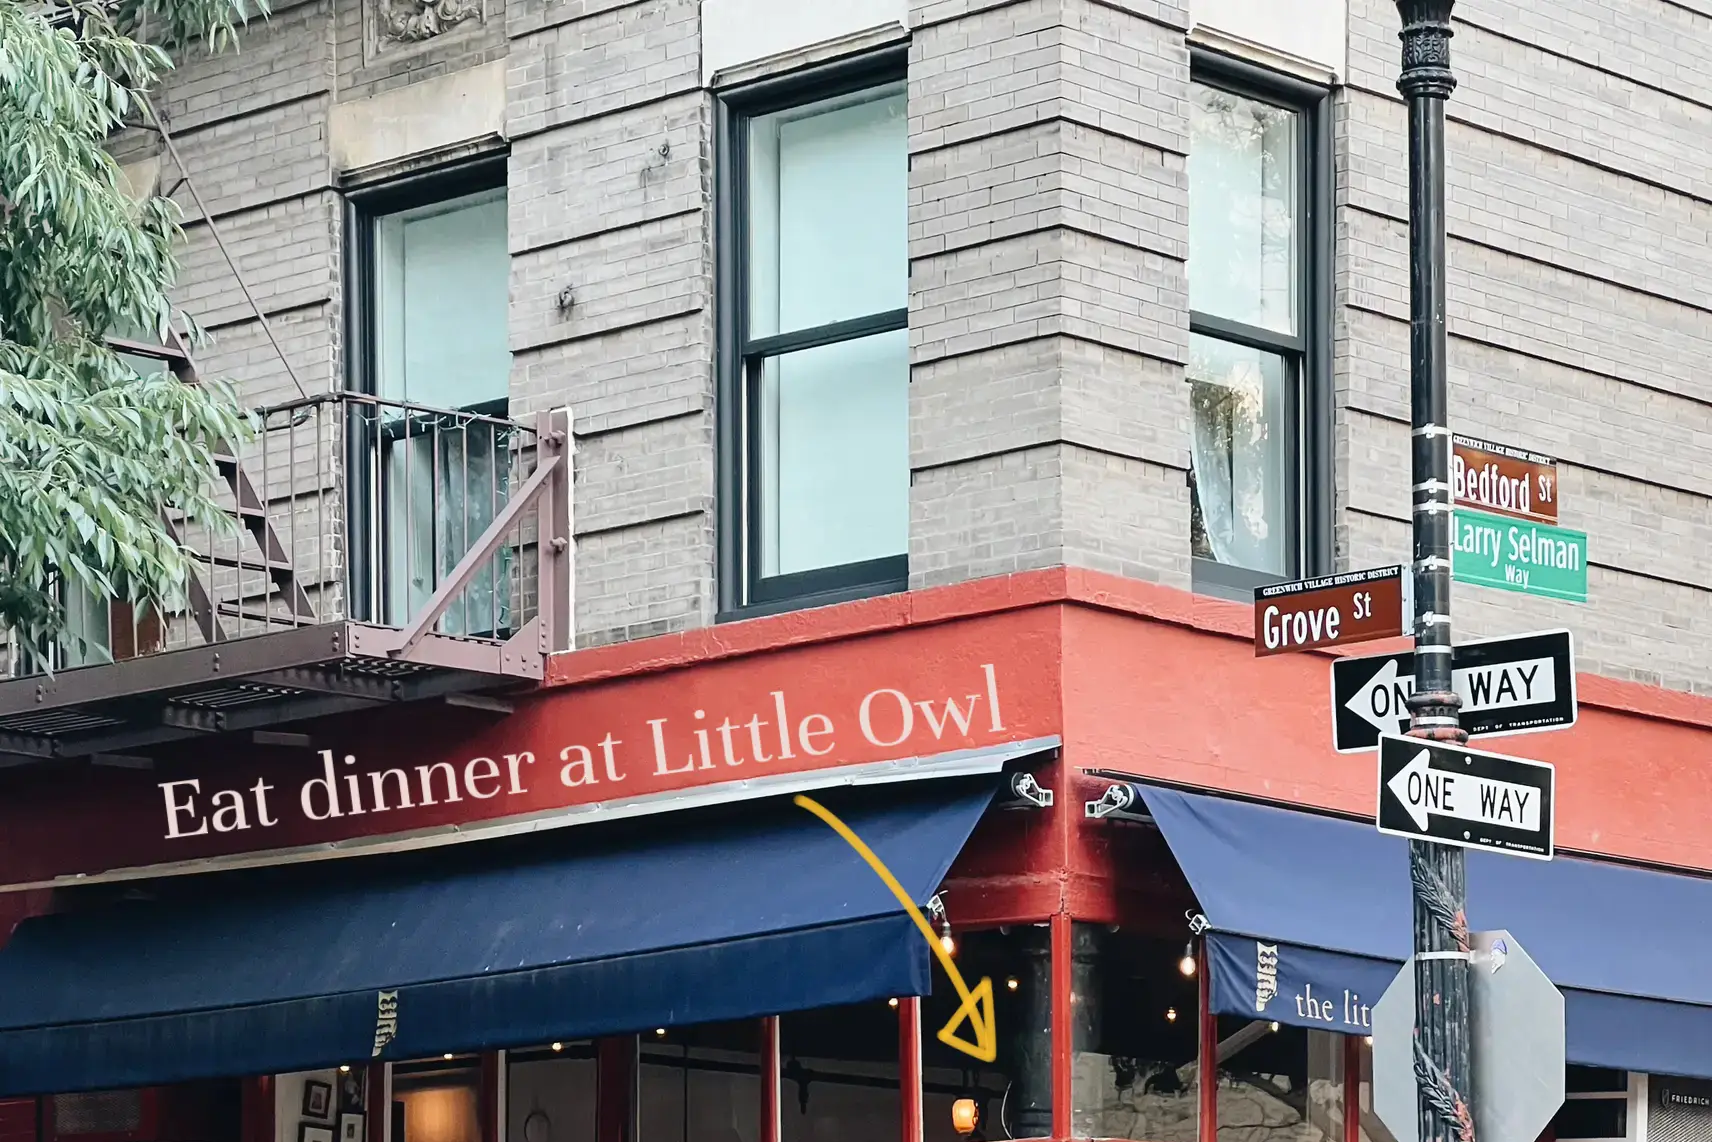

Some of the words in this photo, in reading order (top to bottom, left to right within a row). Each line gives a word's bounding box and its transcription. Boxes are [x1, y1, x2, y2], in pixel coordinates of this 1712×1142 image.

[1453, 435, 1483, 450] GREENWICH
[1484, 442, 1505, 455] VILLAGE
[1453, 455, 1530, 513] Bedford
[1538, 475, 1552, 503] St
[1454, 516, 1502, 567] Larry
[1508, 526, 1579, 571] Selman
[1263, 582, 1303, 596] GREENWICH
[1304, 577, 1333, 590] VILLAGE
[1335, 572, 1366, 585] HISTORIC
[1367, 566, 1399, 580] DISTRICT
[1505, 564, 1529, 589] Way
[1263, 605, 1340, 649] Grove
[1353, 592, 1371, 620] St
[1371, 681, 1412, 718] ON
[1468, 665, 1539, 706] WAY
[1509, 717, 1564, 727] TRANSPORTATION
[1408, 771, 1455, 811] ONE
[1480, 783, 1530, 823] WAY
[1505, 842, 1545, 853] TRANSPORTATION
[1295, 984, 1334, 1021] the
[1344, 989, 1370, 1027] lit
[1671, 1094, 1710, 1106] FRIEDRICH
